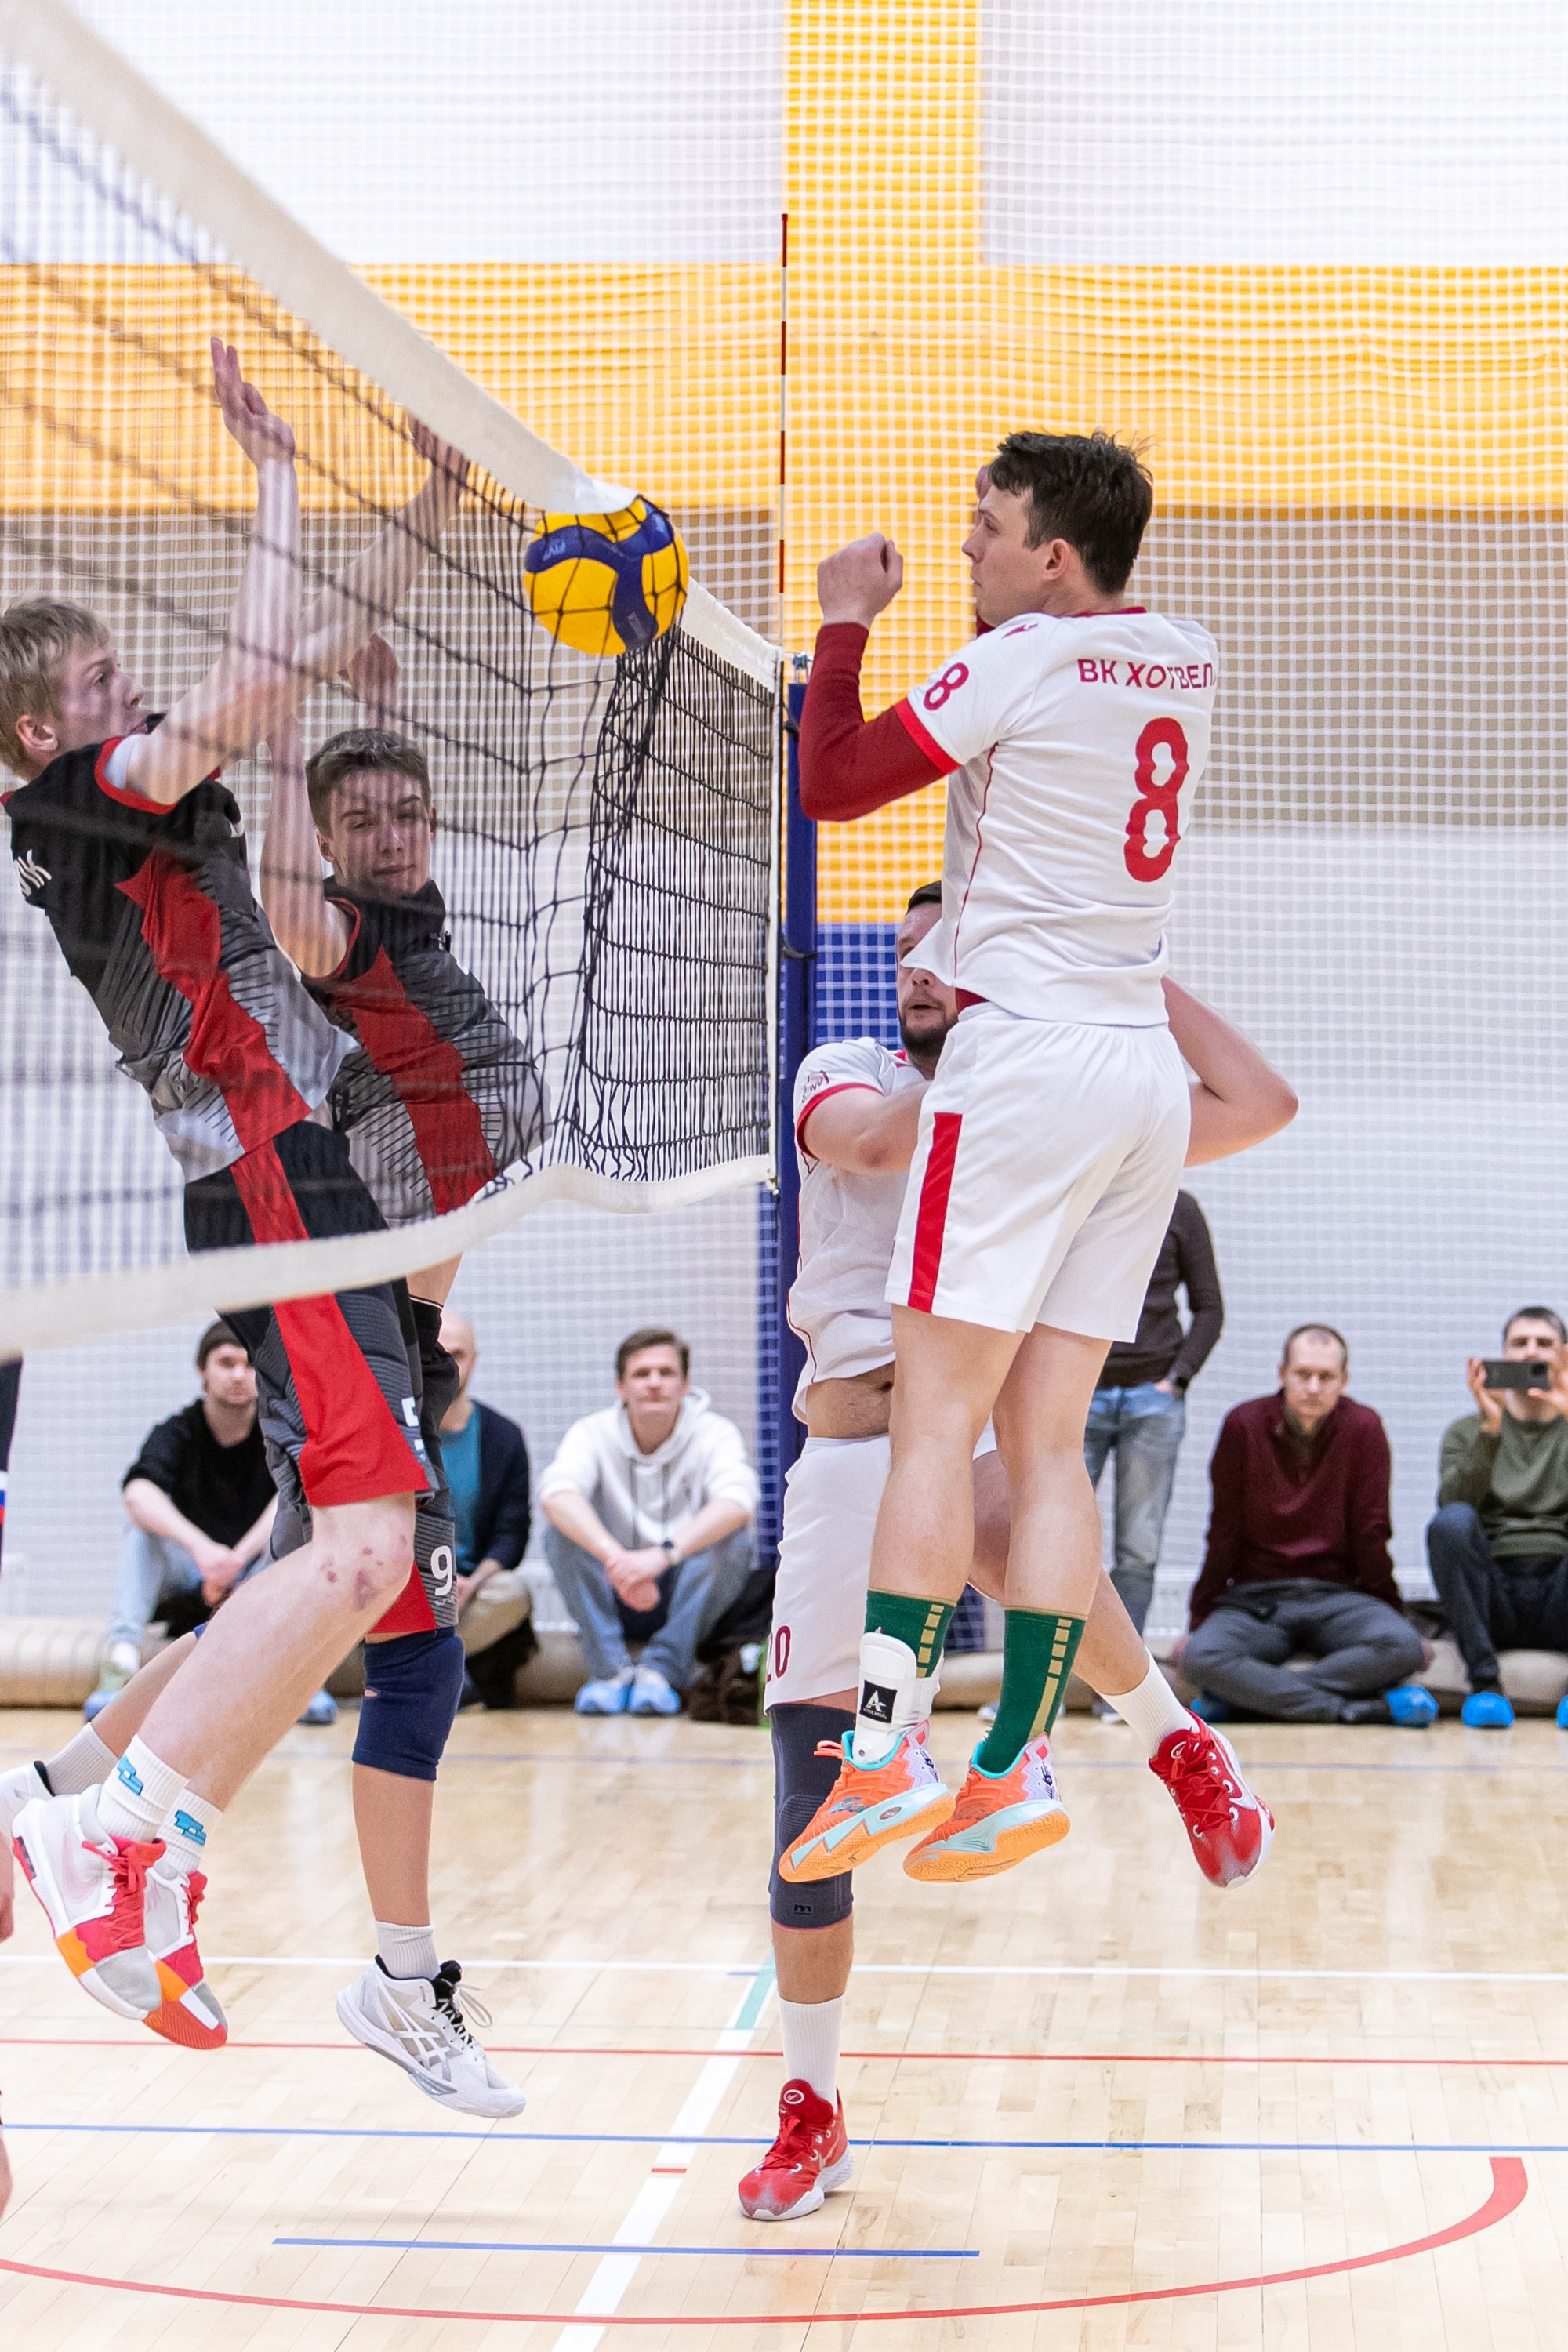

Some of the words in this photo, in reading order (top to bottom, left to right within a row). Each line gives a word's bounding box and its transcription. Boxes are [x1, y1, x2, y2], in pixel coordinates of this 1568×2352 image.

[924, 662, 969, 710] 8
[1077, 658, 1119, 684] ВК
[1123, 717, 1189, 882] 8
[430, 1545, 452, 1596] 9
